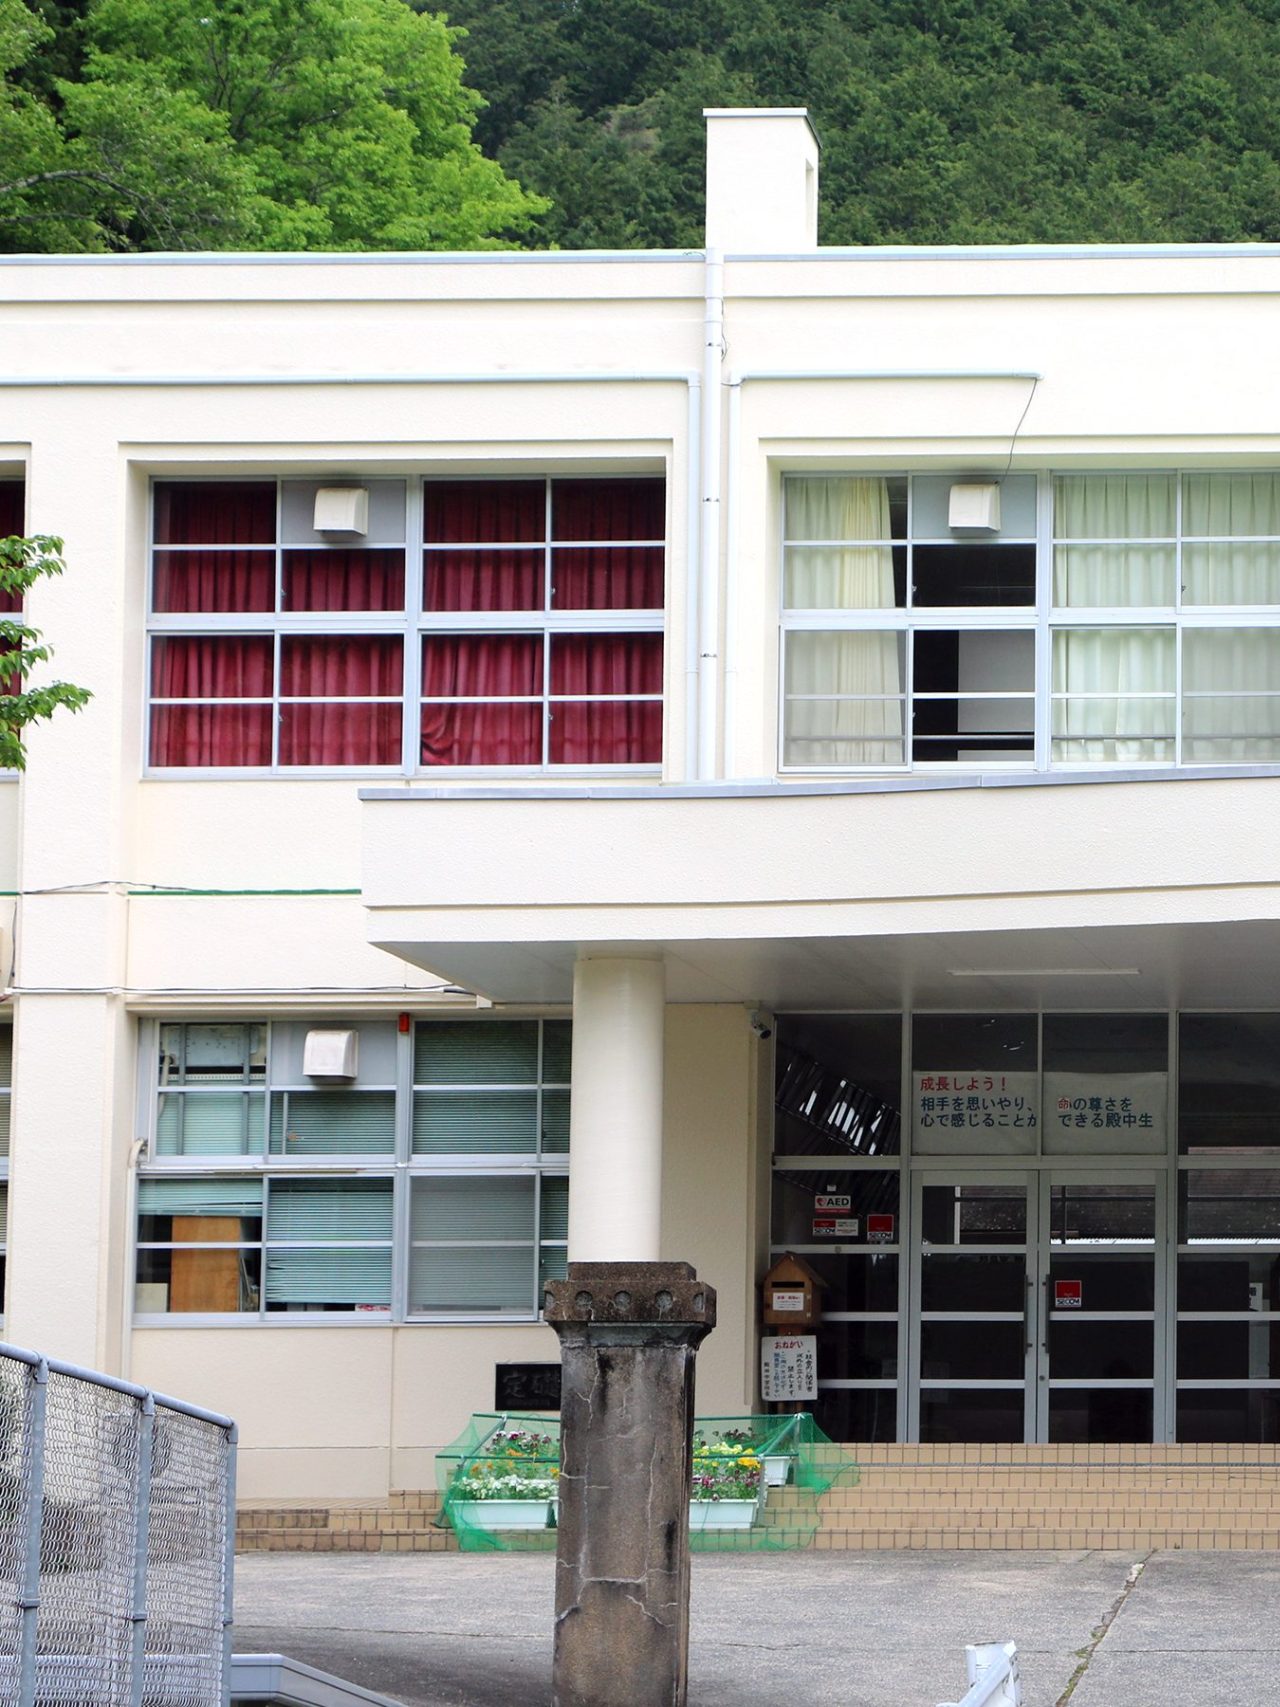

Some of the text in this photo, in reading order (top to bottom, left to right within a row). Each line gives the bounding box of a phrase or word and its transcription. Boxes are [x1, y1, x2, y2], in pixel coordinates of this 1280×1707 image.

[920, 1077, 1006, 1091] 成長しよう！
[921, 1097, 1032, 1111] 相手を思いやり、
[1058, 1113, 1153, 1127] できる殿中生
[827, 1198, 849, 1206] AED
